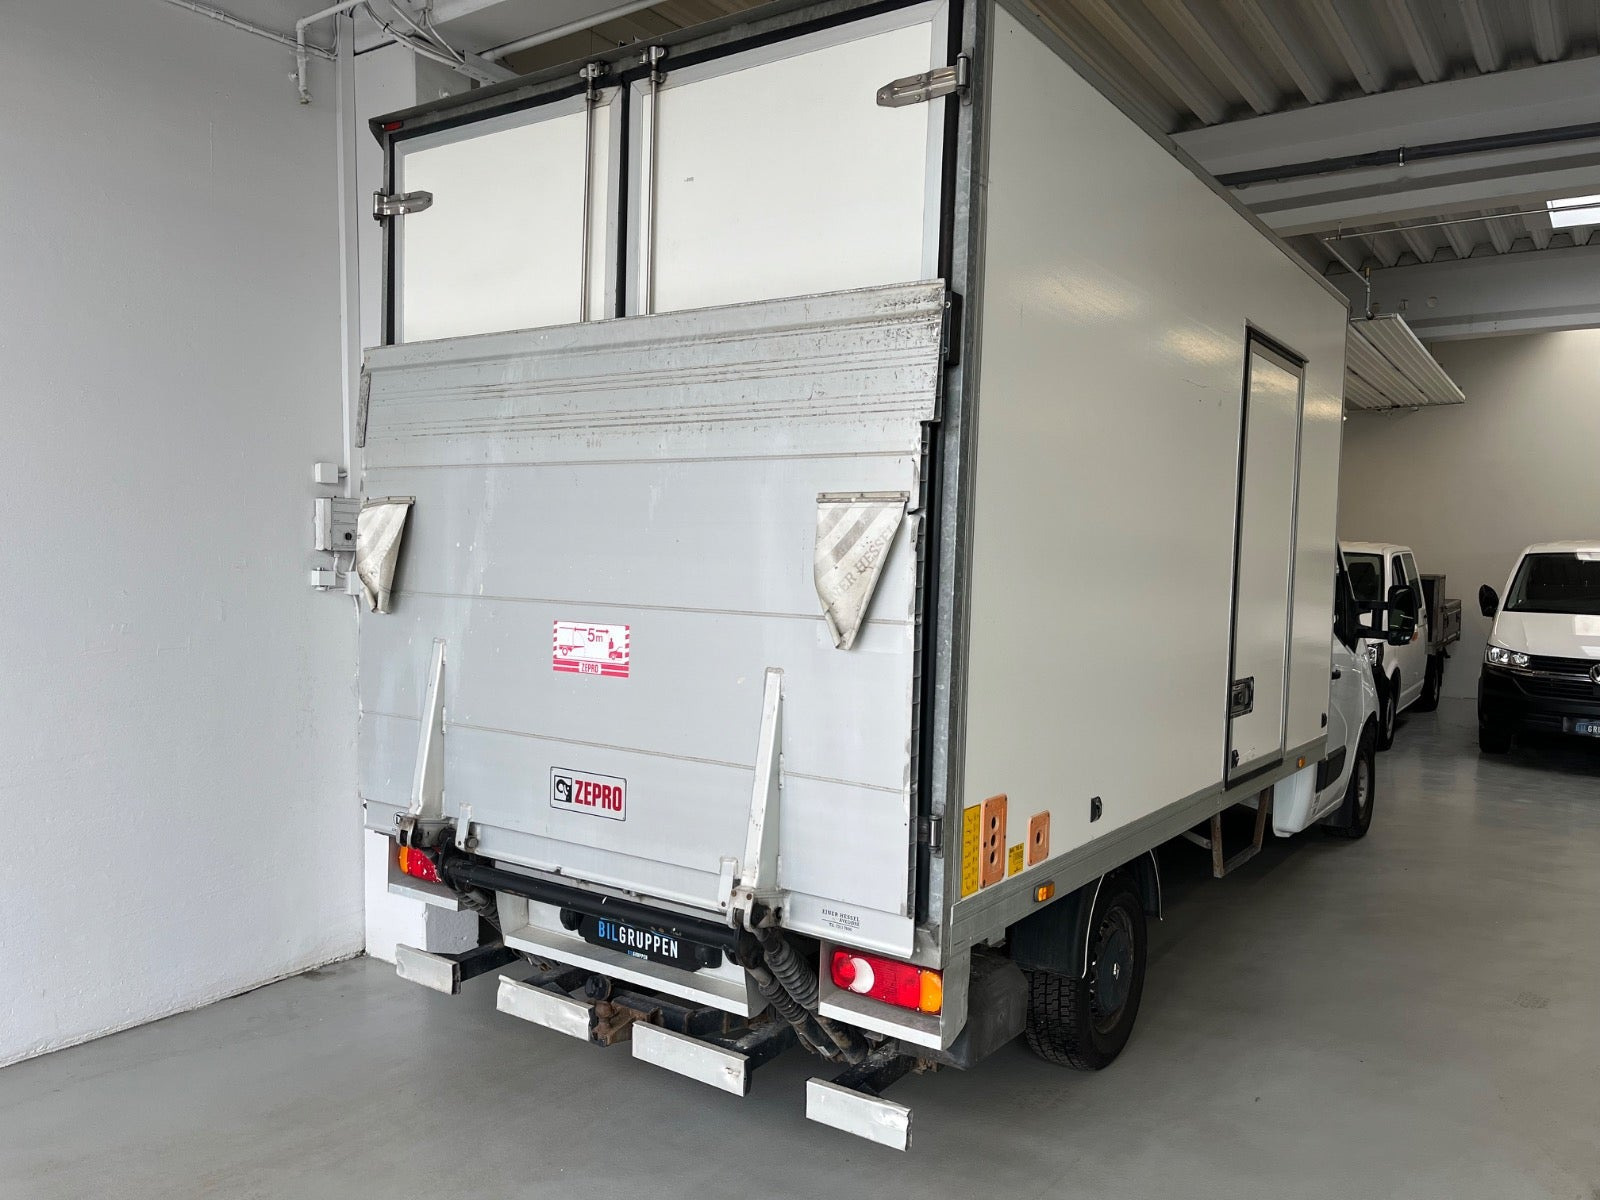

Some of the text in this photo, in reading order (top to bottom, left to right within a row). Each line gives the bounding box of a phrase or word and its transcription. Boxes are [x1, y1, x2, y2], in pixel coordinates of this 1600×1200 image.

[581, 663, 599, 673] ZEPRO
[574, 780, 622, 812] ZEPRO
[598, 920, 678, 959] BILGRUPPEN
